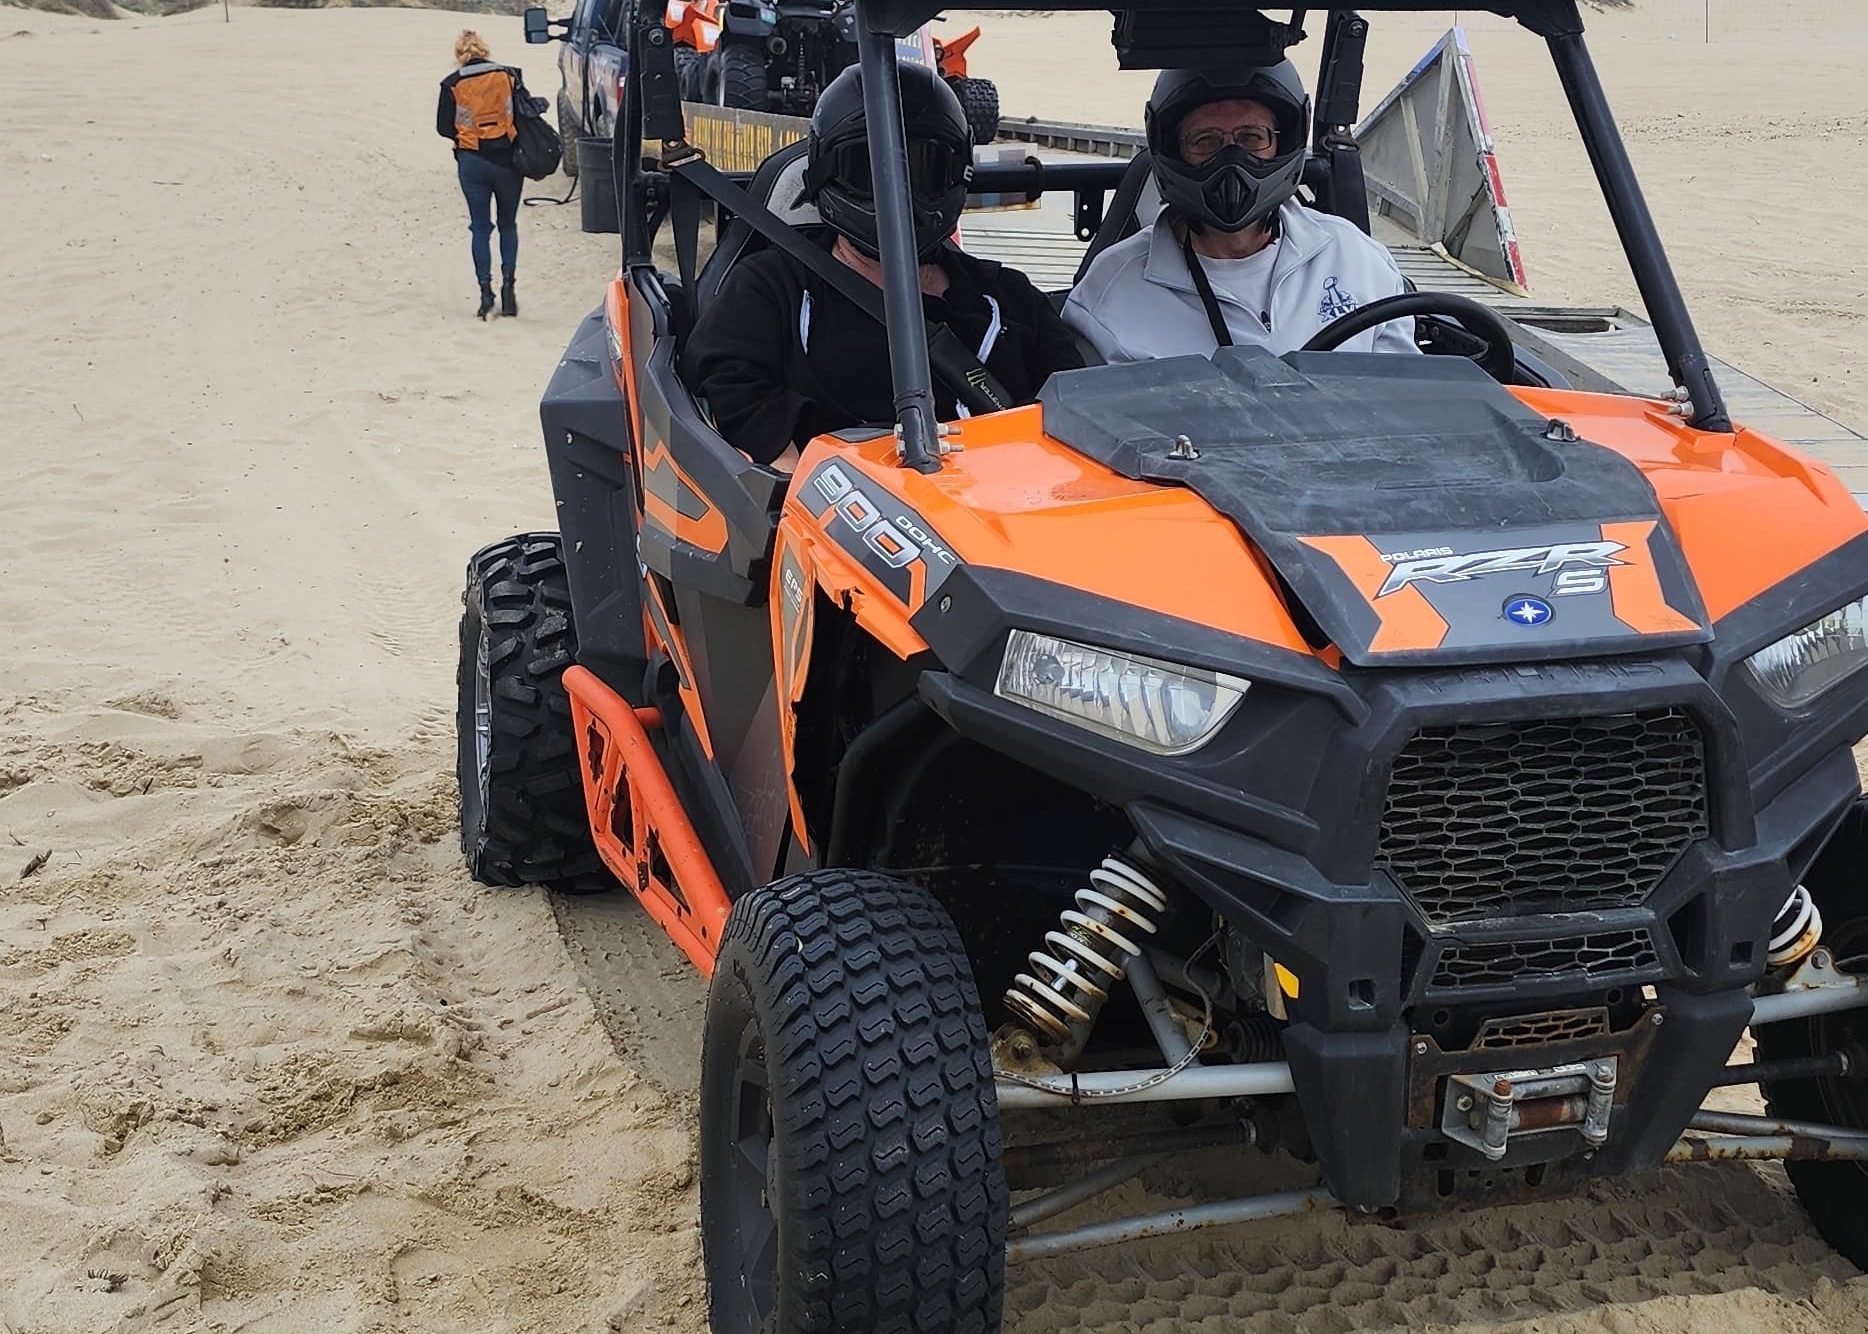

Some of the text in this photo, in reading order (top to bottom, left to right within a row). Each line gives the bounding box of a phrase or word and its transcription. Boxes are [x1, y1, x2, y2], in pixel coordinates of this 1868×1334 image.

[813, 463, 922, 569] 900
[896, 515, 956, 565] DOHC
[1375, 541, 1632, 598] RZR
[1379, 546, 1453, 563] POLARIS
[1554, 569, 1607, 595] S
